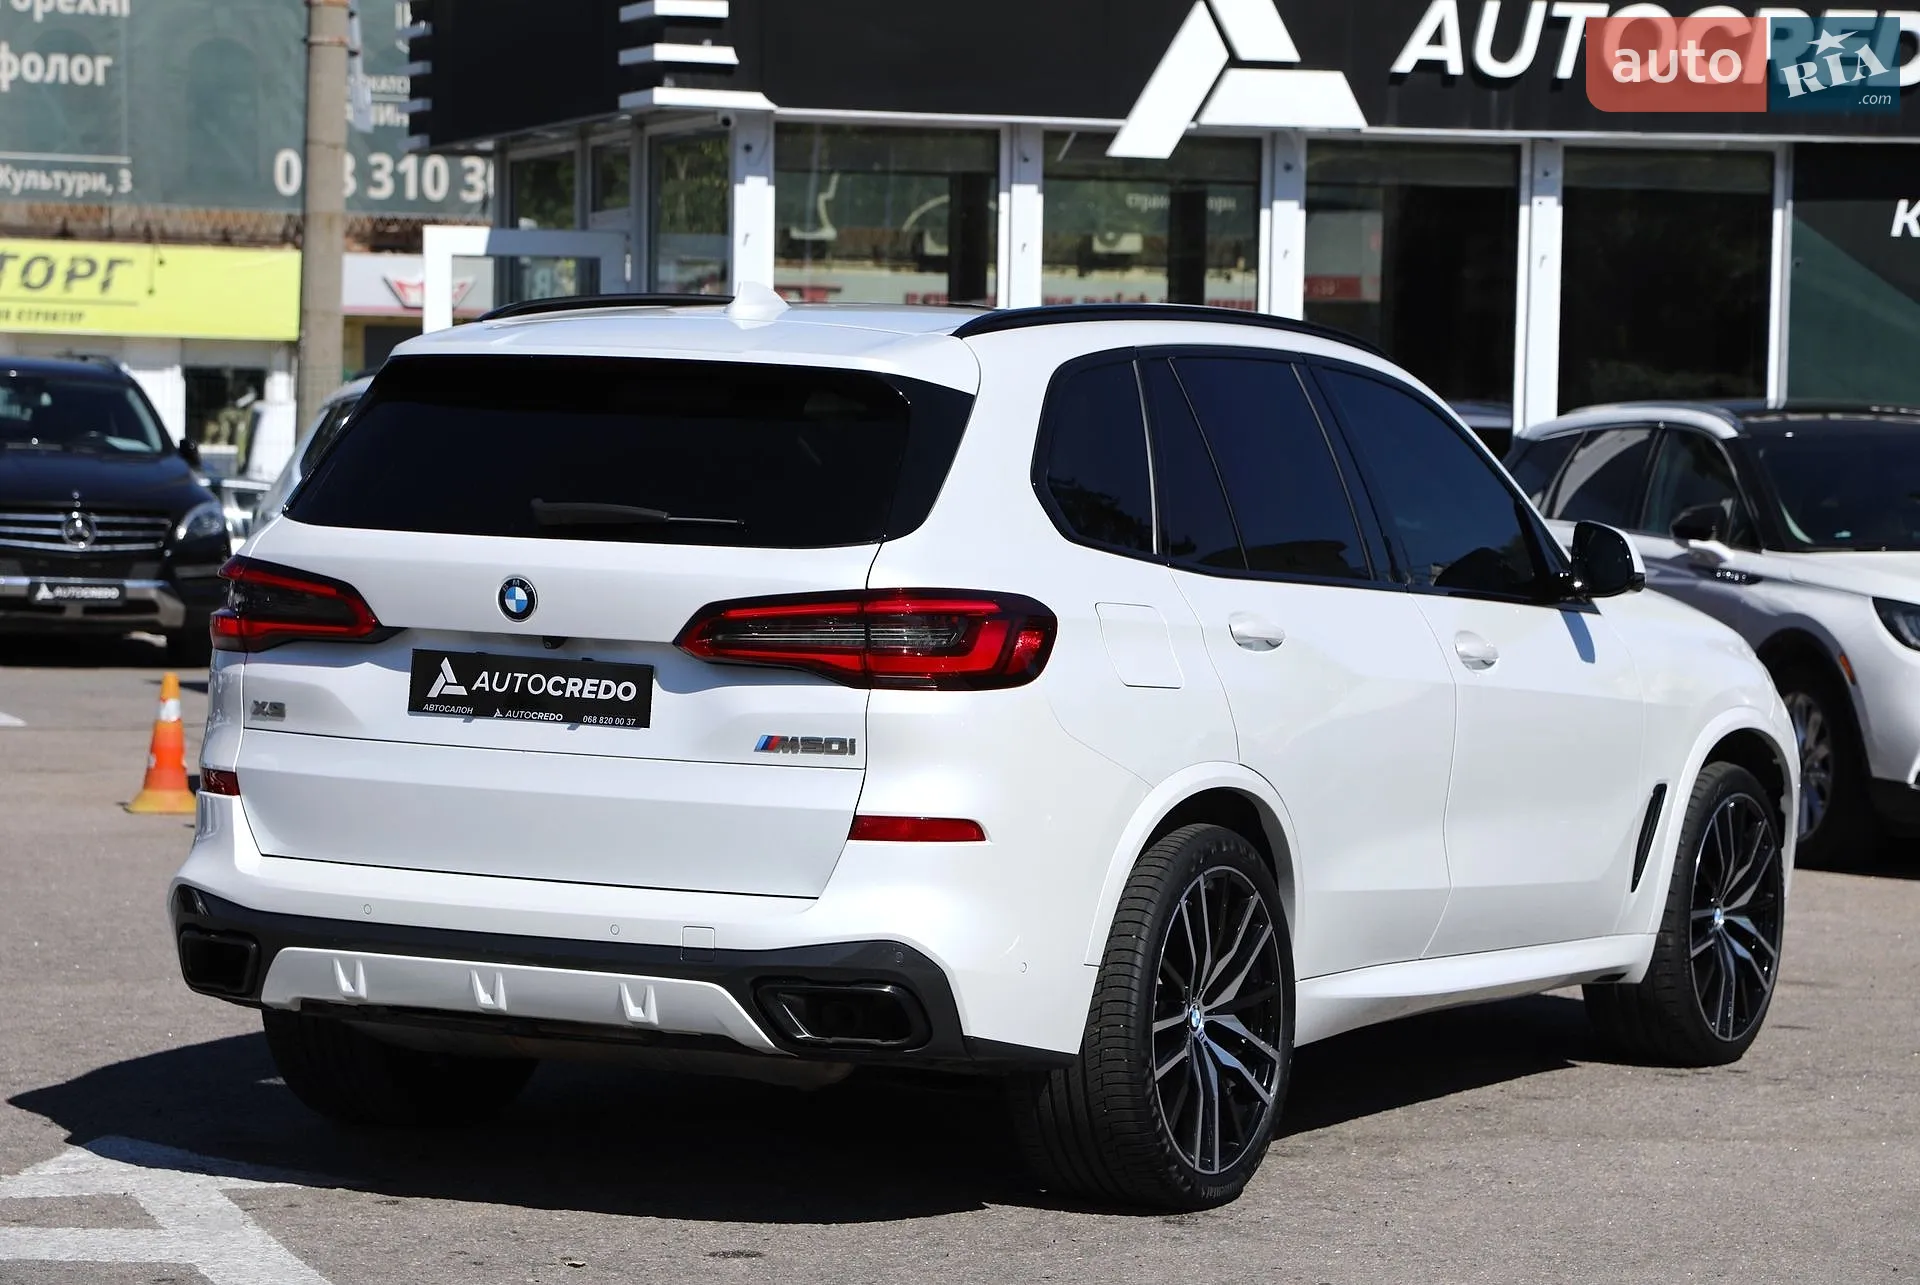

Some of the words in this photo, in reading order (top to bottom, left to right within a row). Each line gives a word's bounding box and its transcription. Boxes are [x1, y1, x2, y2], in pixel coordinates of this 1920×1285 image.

[118, 168, 133, 193] 3
[367, 152, 450, 201] 310
[459, 155, 495, 202] 3
[471, 671, 637, 702] AUTOCREDO
[422, 703, 474, 715] АВТОСАЛОН
[505, 710, 564, 721] AUTOCREDO
[582, 715, 597, 724] 068
[598, 716, 613, 725] 820
[614, 717, 625, 726] 00
[626, 718, 636, 726] 37
